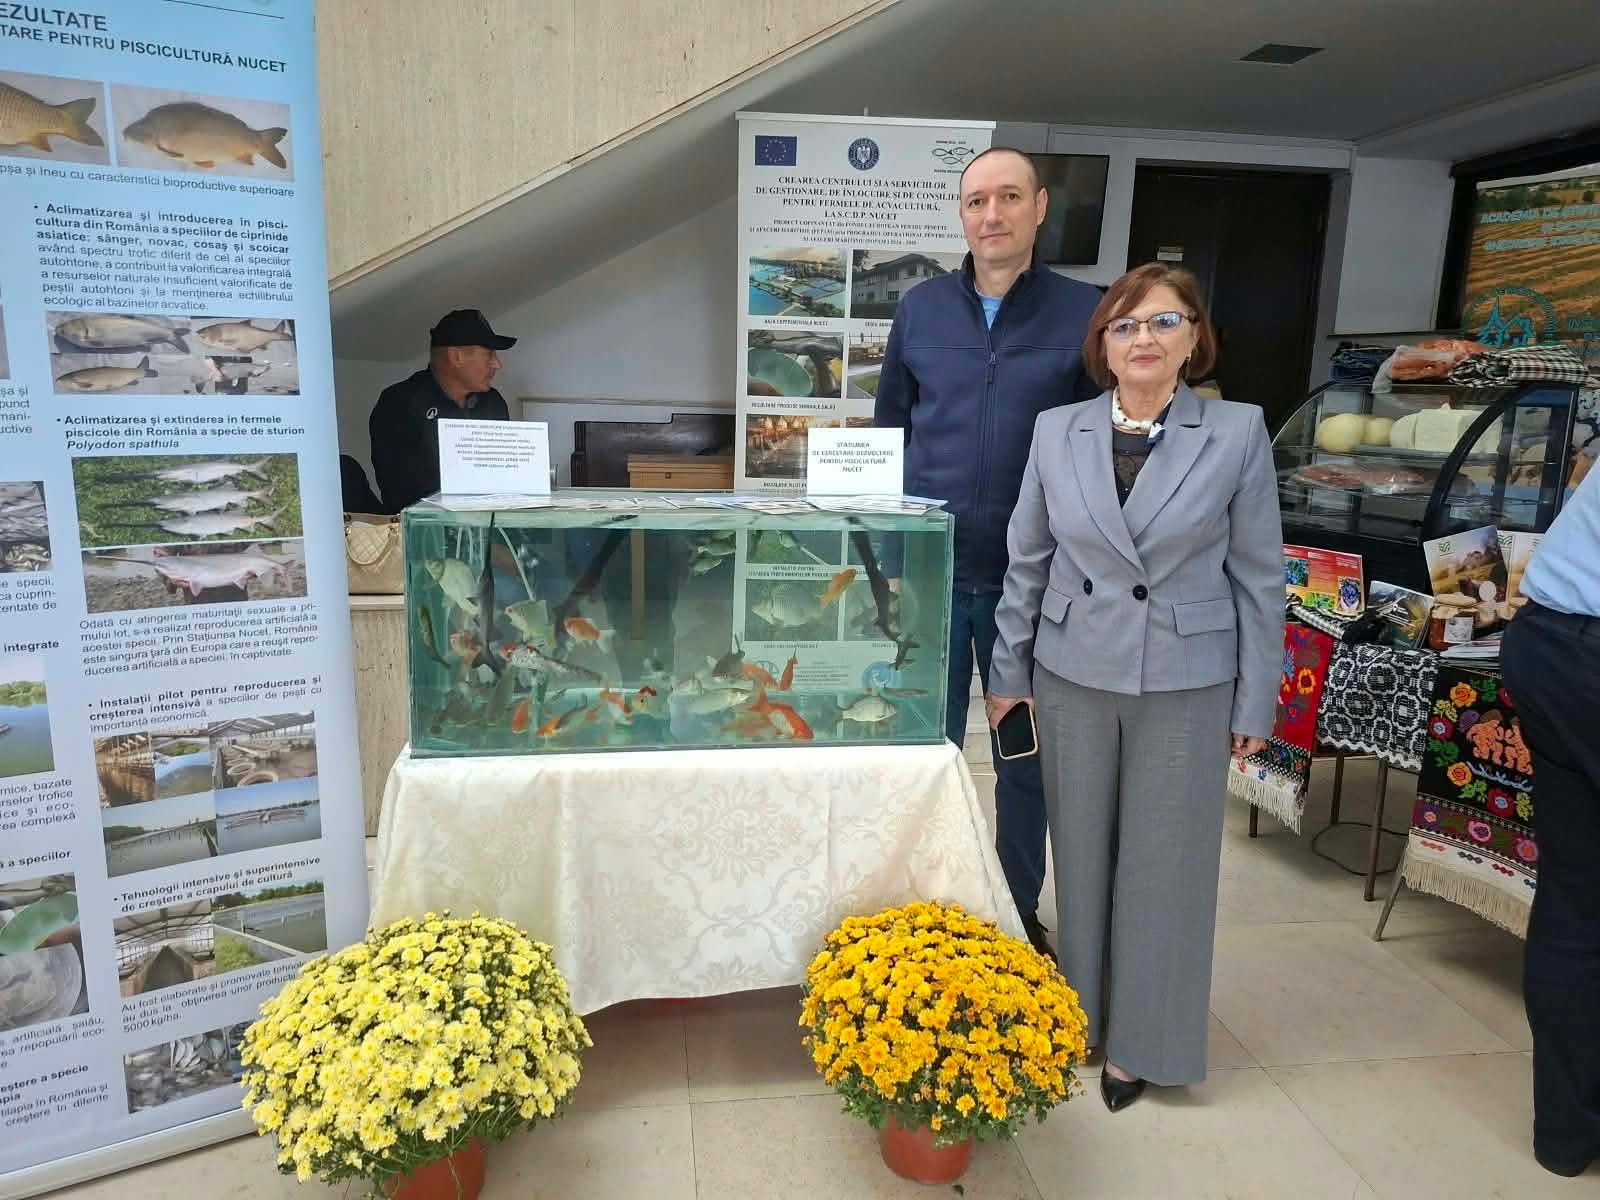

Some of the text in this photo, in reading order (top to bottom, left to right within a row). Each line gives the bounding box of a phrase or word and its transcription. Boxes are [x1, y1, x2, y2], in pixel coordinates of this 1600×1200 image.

[0, 23, 286, 73] TARE PENTRU PISCICULTURĂ NUCET
[70, 172, 84, 180] cu
[88, 173, 160, 186] caracteristici
[163, 177, 237, 193] bioproductive
[239, 185, 295, 197] superioare
[46, 203, 132, 219] Aclimatizarea
[158, 211, 232, 226] introducerea
[257, 218, 288, 230] pisci-
[35, 217, 288, 242] cultura din România a speciilor de ciprinide
[80, 246, 123, 257] spectru
[195, 251, 209, 261] de
[234, 253, 244, 263] al
[248, 242, 289, 253] scoicar
[105, 260, 113, 268] a
[179, 262, 245, 275] valorificarea
[40, 270, 49, 278] a
[52, 271, 110, 281] resurselor
[114, 272, 160, 284] naturale
[220, 277, 276, 289] valorificate
[279, 279, 293, 290] de
[64, 414, 147, 424] Aclimatizarea
[163, 414, 224, 424] extinderea
[65, 425, 305, 439] piscicole din România a specie de sturion
[67, 438, 179, 451] Polyodon spathula
[194, 618, 263, 632] reproducerea
[3, 639, 60, 652] integrate
[83, 653, 106, 664] este
[173, 645, 188, 655] din
[84, 664, 130, 676] ducerea
[158, 689, 183, 703] pilot
[190, 685, 227, 700] pentru
[233, 677, 306, 693] reproducerea
[89, 707, 144, 721] creșterea
[150, 698, 201, 713] intensivă
[206, 699, 213, 707] a
[264, 689, 277, 700] de
[311, 686, 322, 694] cu
[19, 850, 70, 866] speciilor
[121, 882, 179, 901] Tehnologii
[182, 873, 230, 889] intensive
[245, 856, 320, 877] superintensive
[120, 903, 135, 913] de
[186, 892, 192, 900] a
[195, 880, 239, 898] crapului
[241, 878, 254, 888] de
